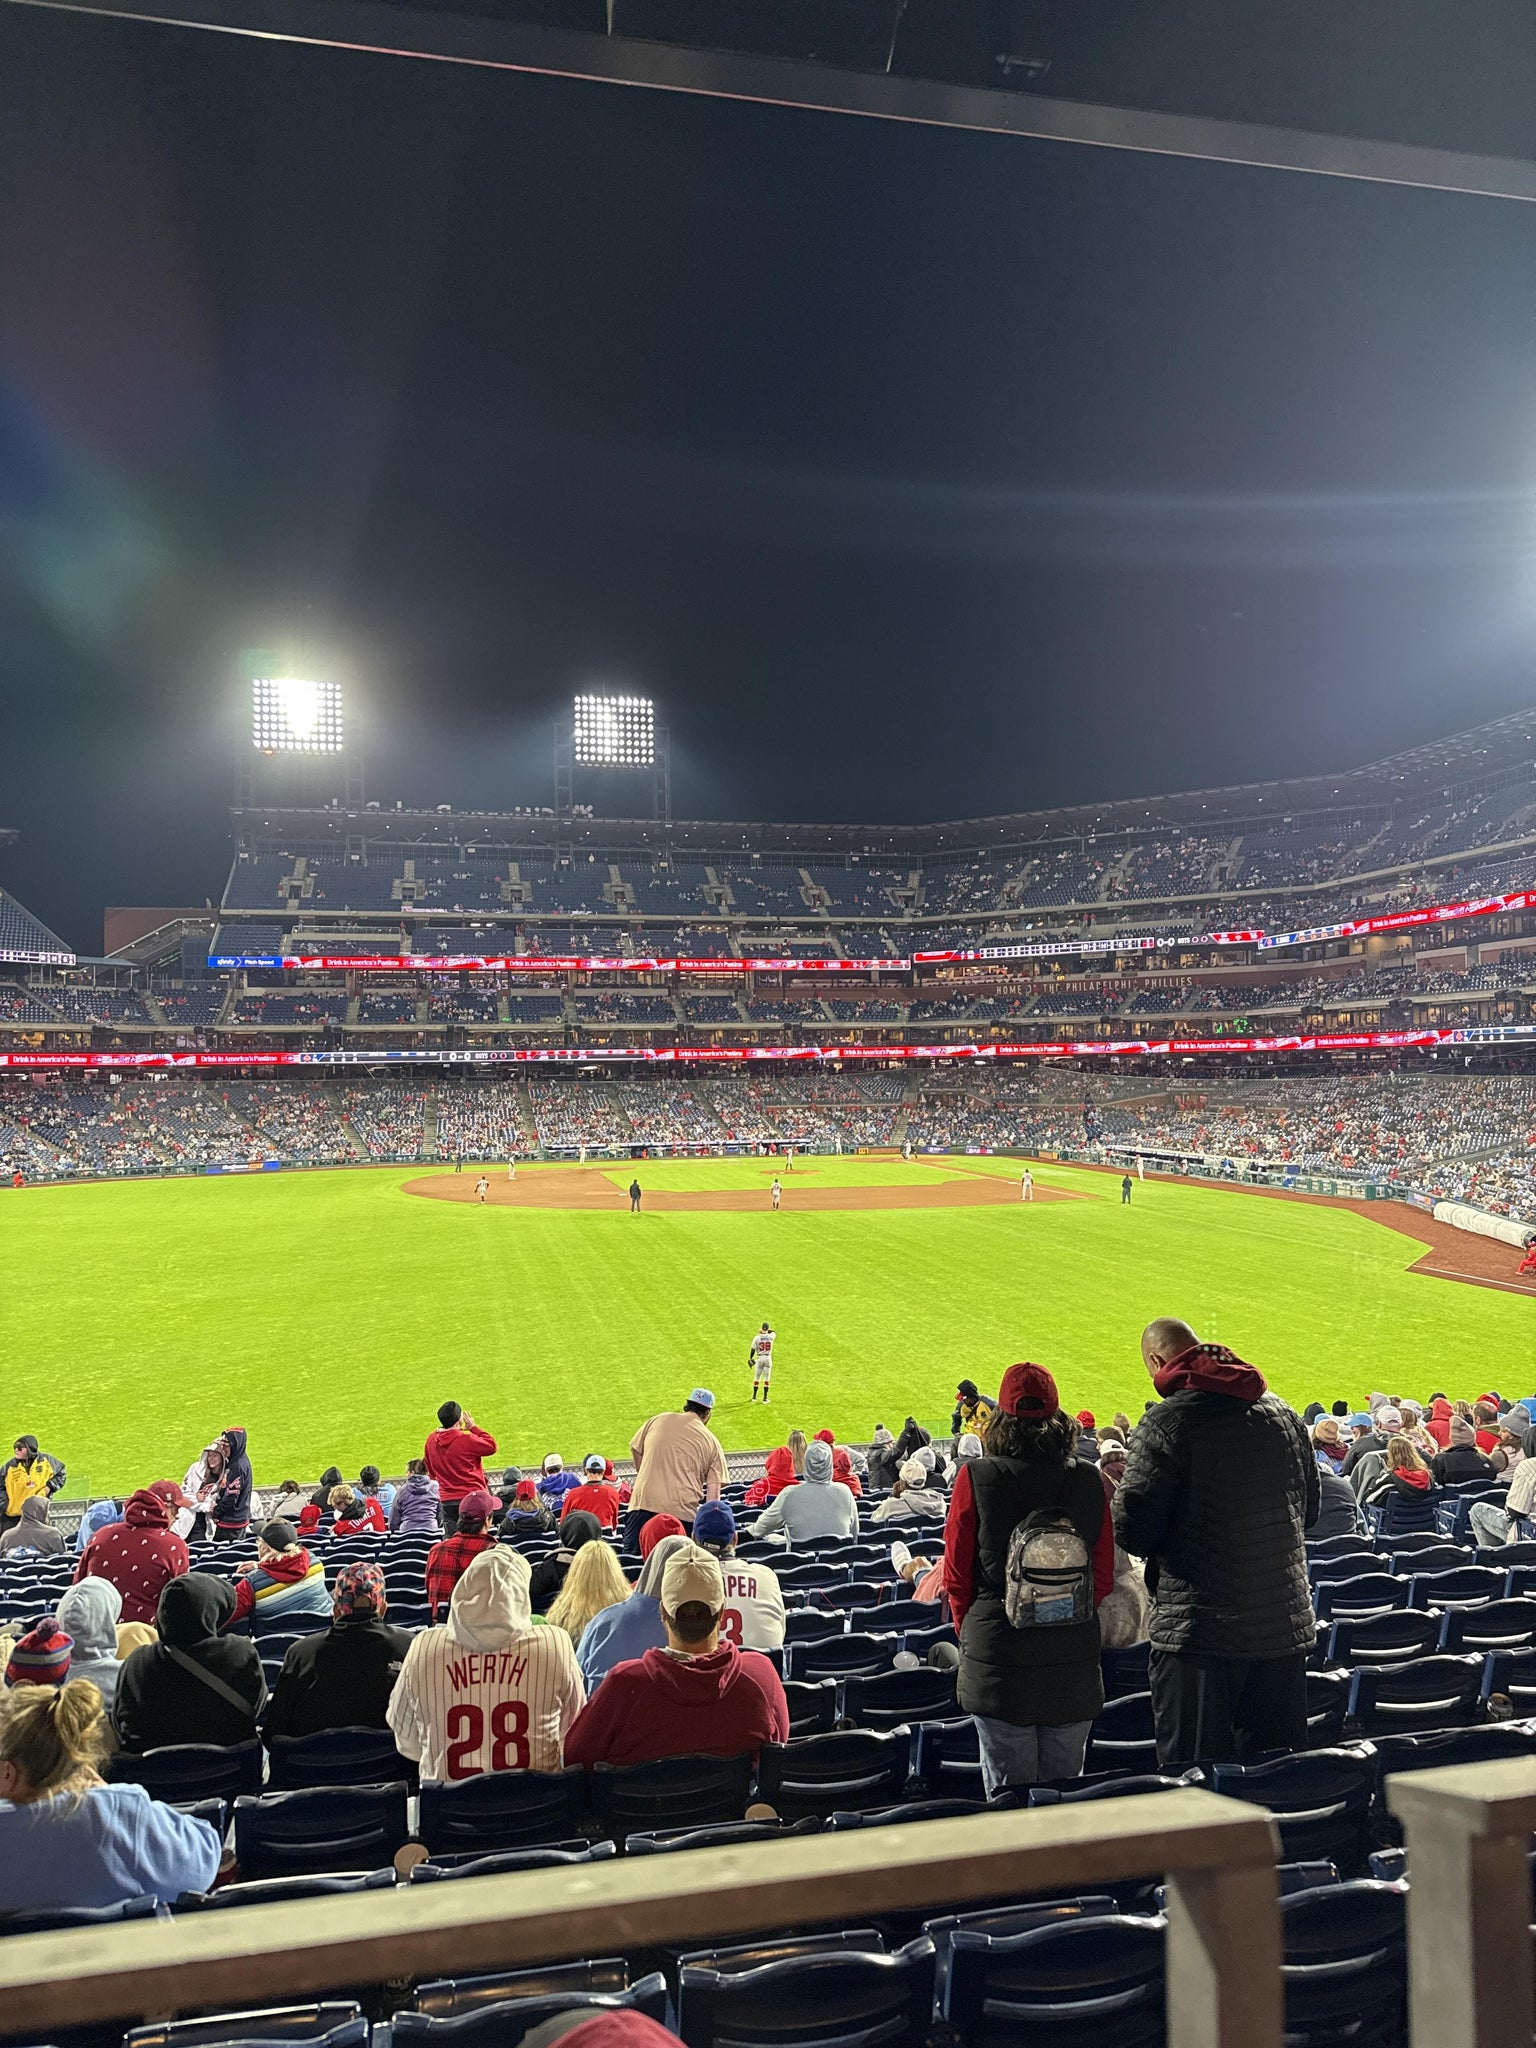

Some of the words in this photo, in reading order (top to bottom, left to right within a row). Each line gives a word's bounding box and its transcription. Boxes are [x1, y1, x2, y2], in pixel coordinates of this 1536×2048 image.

[257, 959, 275, 967] Speed
[996, 985, 1022, 995] HOME
[1144, 977, 1193, 989] PHILLIES
[1225, 1041, 1248, 1049] Pastime
[64, 1055, 88, 1063] Pastime
[723, 1575, 758, 1599] PER
[719, 1608, 744, 1647] 3
[446, 1653, 528, 1693] WERTH
[446, 1700, 531, 1781] 28
